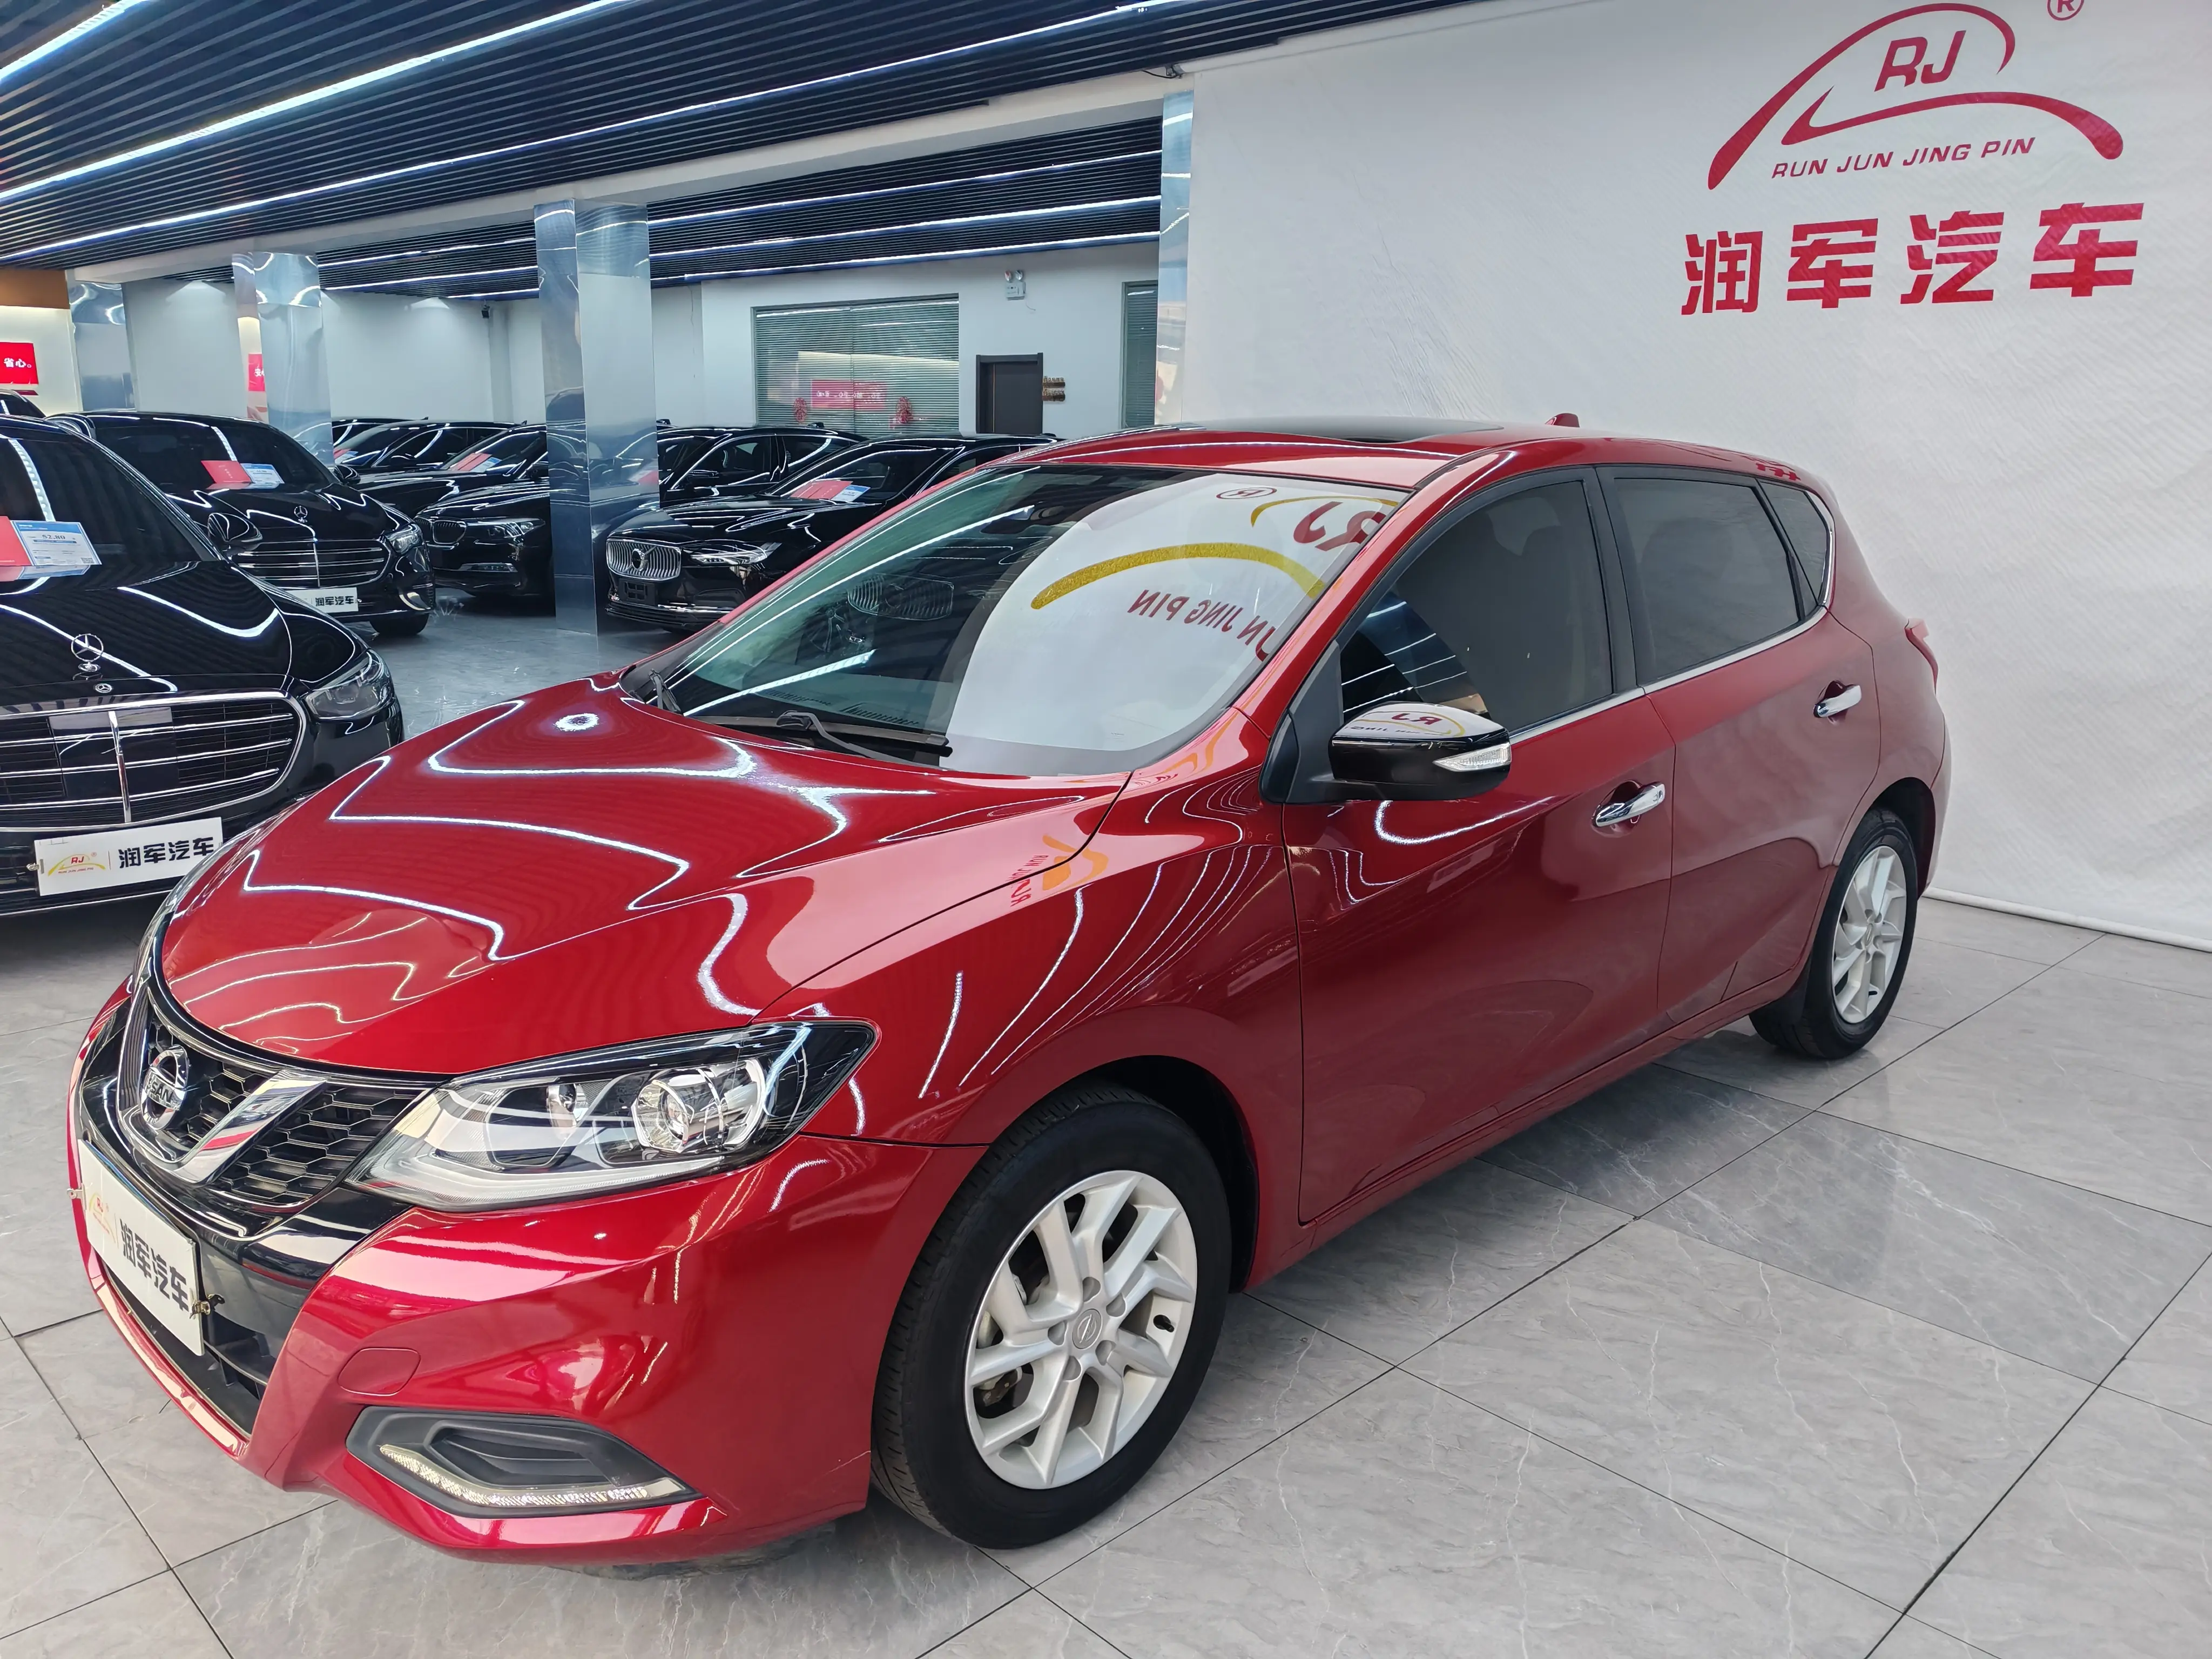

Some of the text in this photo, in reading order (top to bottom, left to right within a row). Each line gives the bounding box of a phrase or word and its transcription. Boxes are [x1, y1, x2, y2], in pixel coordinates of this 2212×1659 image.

[1874, 30, 1966, 92] RJ
[1771, 137, 2035, 179] RUN JUN JING PIN
[1681, 203, 2144, 315] 润军汽车
[315, 596, 354, 606] 润军汽车
[71, 856, 84, 864] RJ
[118, 837, 214, 869] 润军汽车
[119, 1218, 190, 1313] 润军汽车
